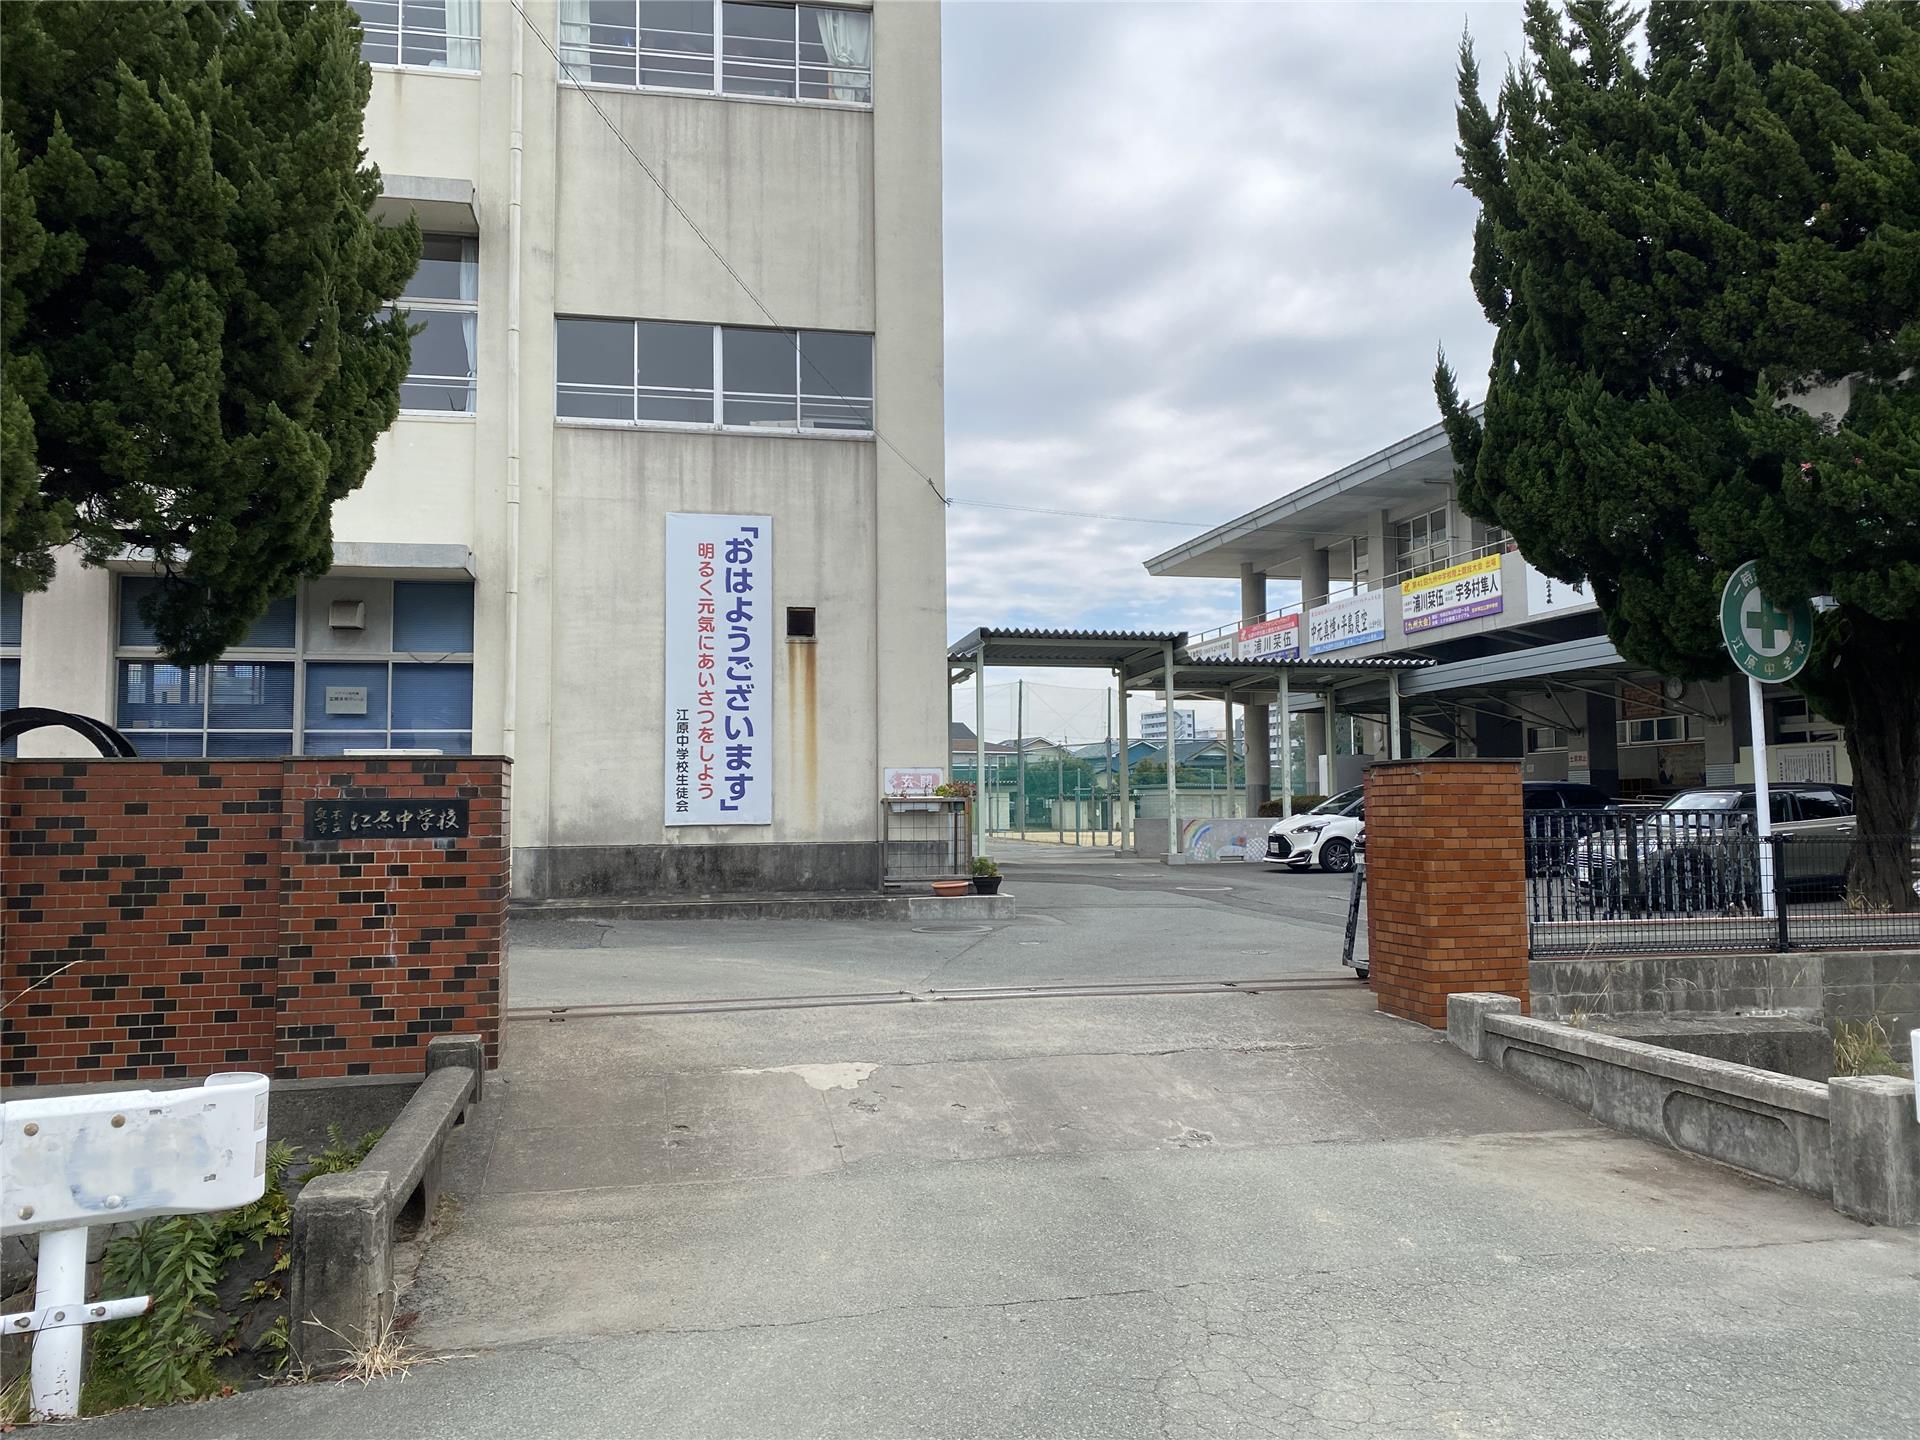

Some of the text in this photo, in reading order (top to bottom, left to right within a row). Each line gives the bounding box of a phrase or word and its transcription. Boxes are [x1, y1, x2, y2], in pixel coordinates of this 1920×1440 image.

[697, 542, 715, 800] 明るく元気にあいさつをしよう
[720, 526, 759, 812] 「おはようございます」
[1731, 636, 1806, 676] 江原中学校
[675, 708, 689, 813] 江原中学校生徒会
[901, 774, 933, 788] 玄関
[350, 807, 459, 832] 江原中学校
